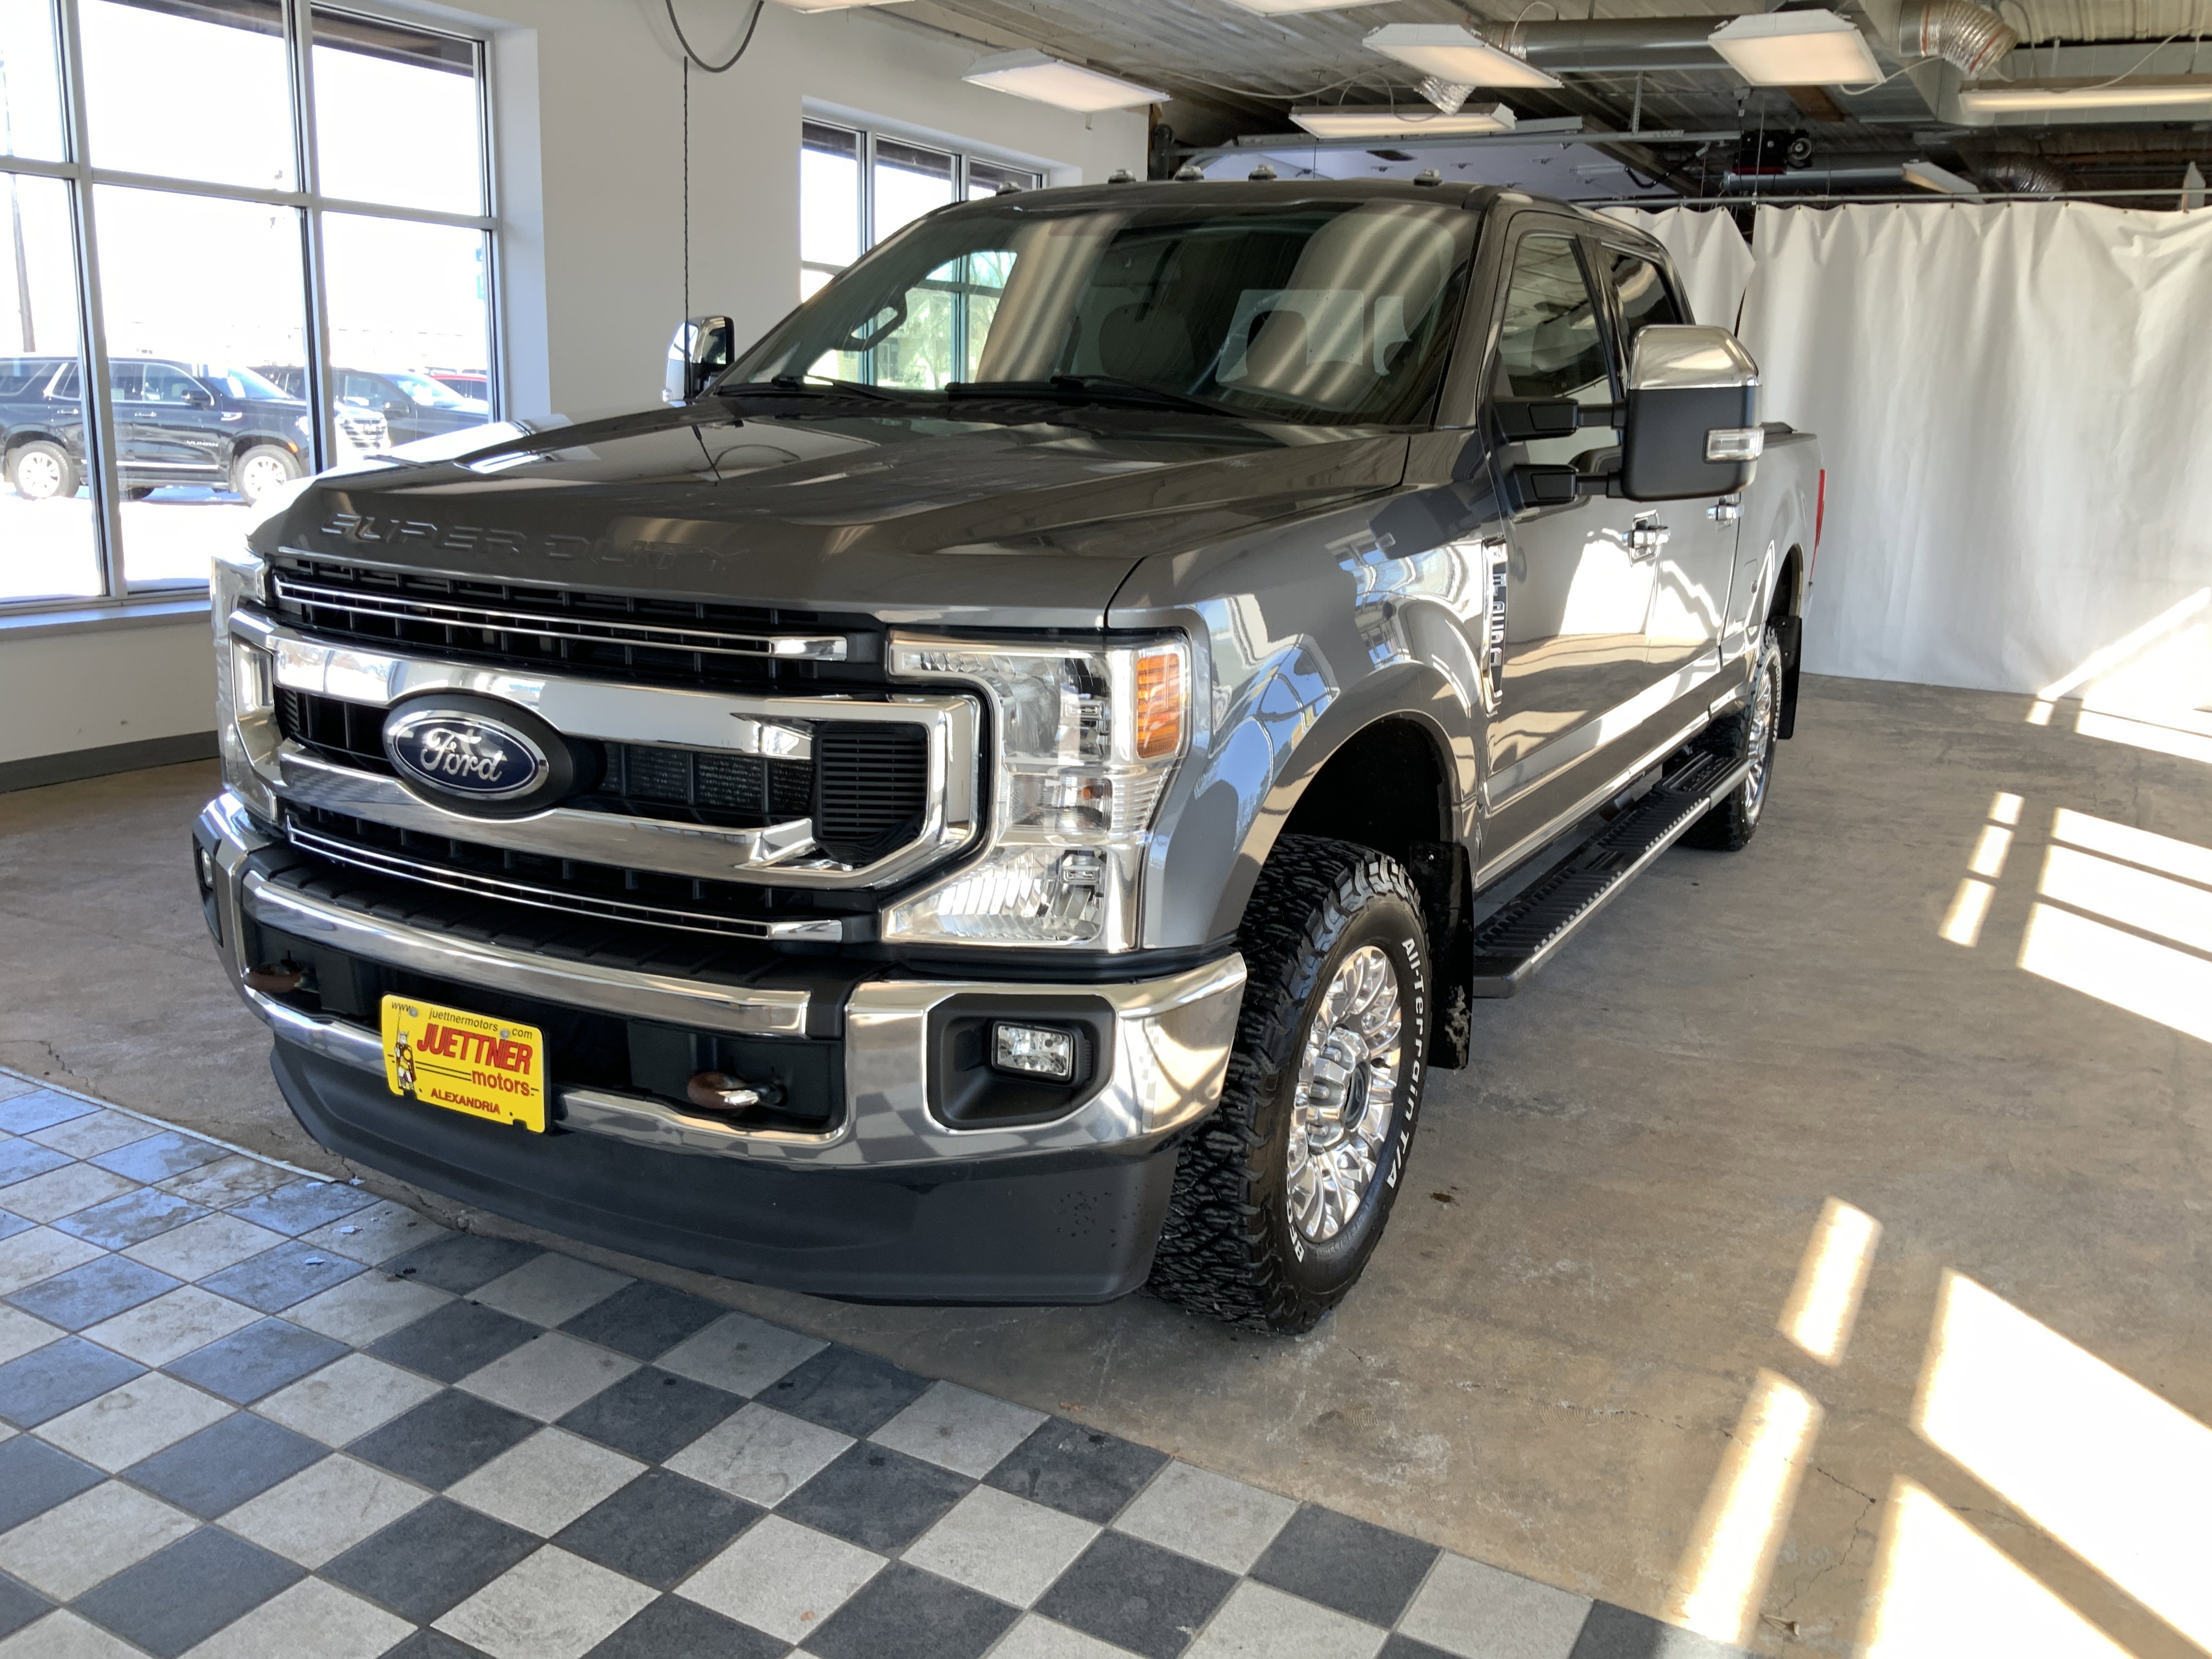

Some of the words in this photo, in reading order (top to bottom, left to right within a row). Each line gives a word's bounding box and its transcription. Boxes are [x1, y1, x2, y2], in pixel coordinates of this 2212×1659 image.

[321, 512, 527, 554] SUPER
[420, 727, 504, 782] Ford
[416, 1023, 533, 1075] JUETTNER
[1401, 937, 1425, 1121] All-Terrain
[430, 1087, 501, 1115] ALEXANDRIA
[472, 1070, 531, 1097] motors
[1386, 1130, 1409, 1189] T/A
